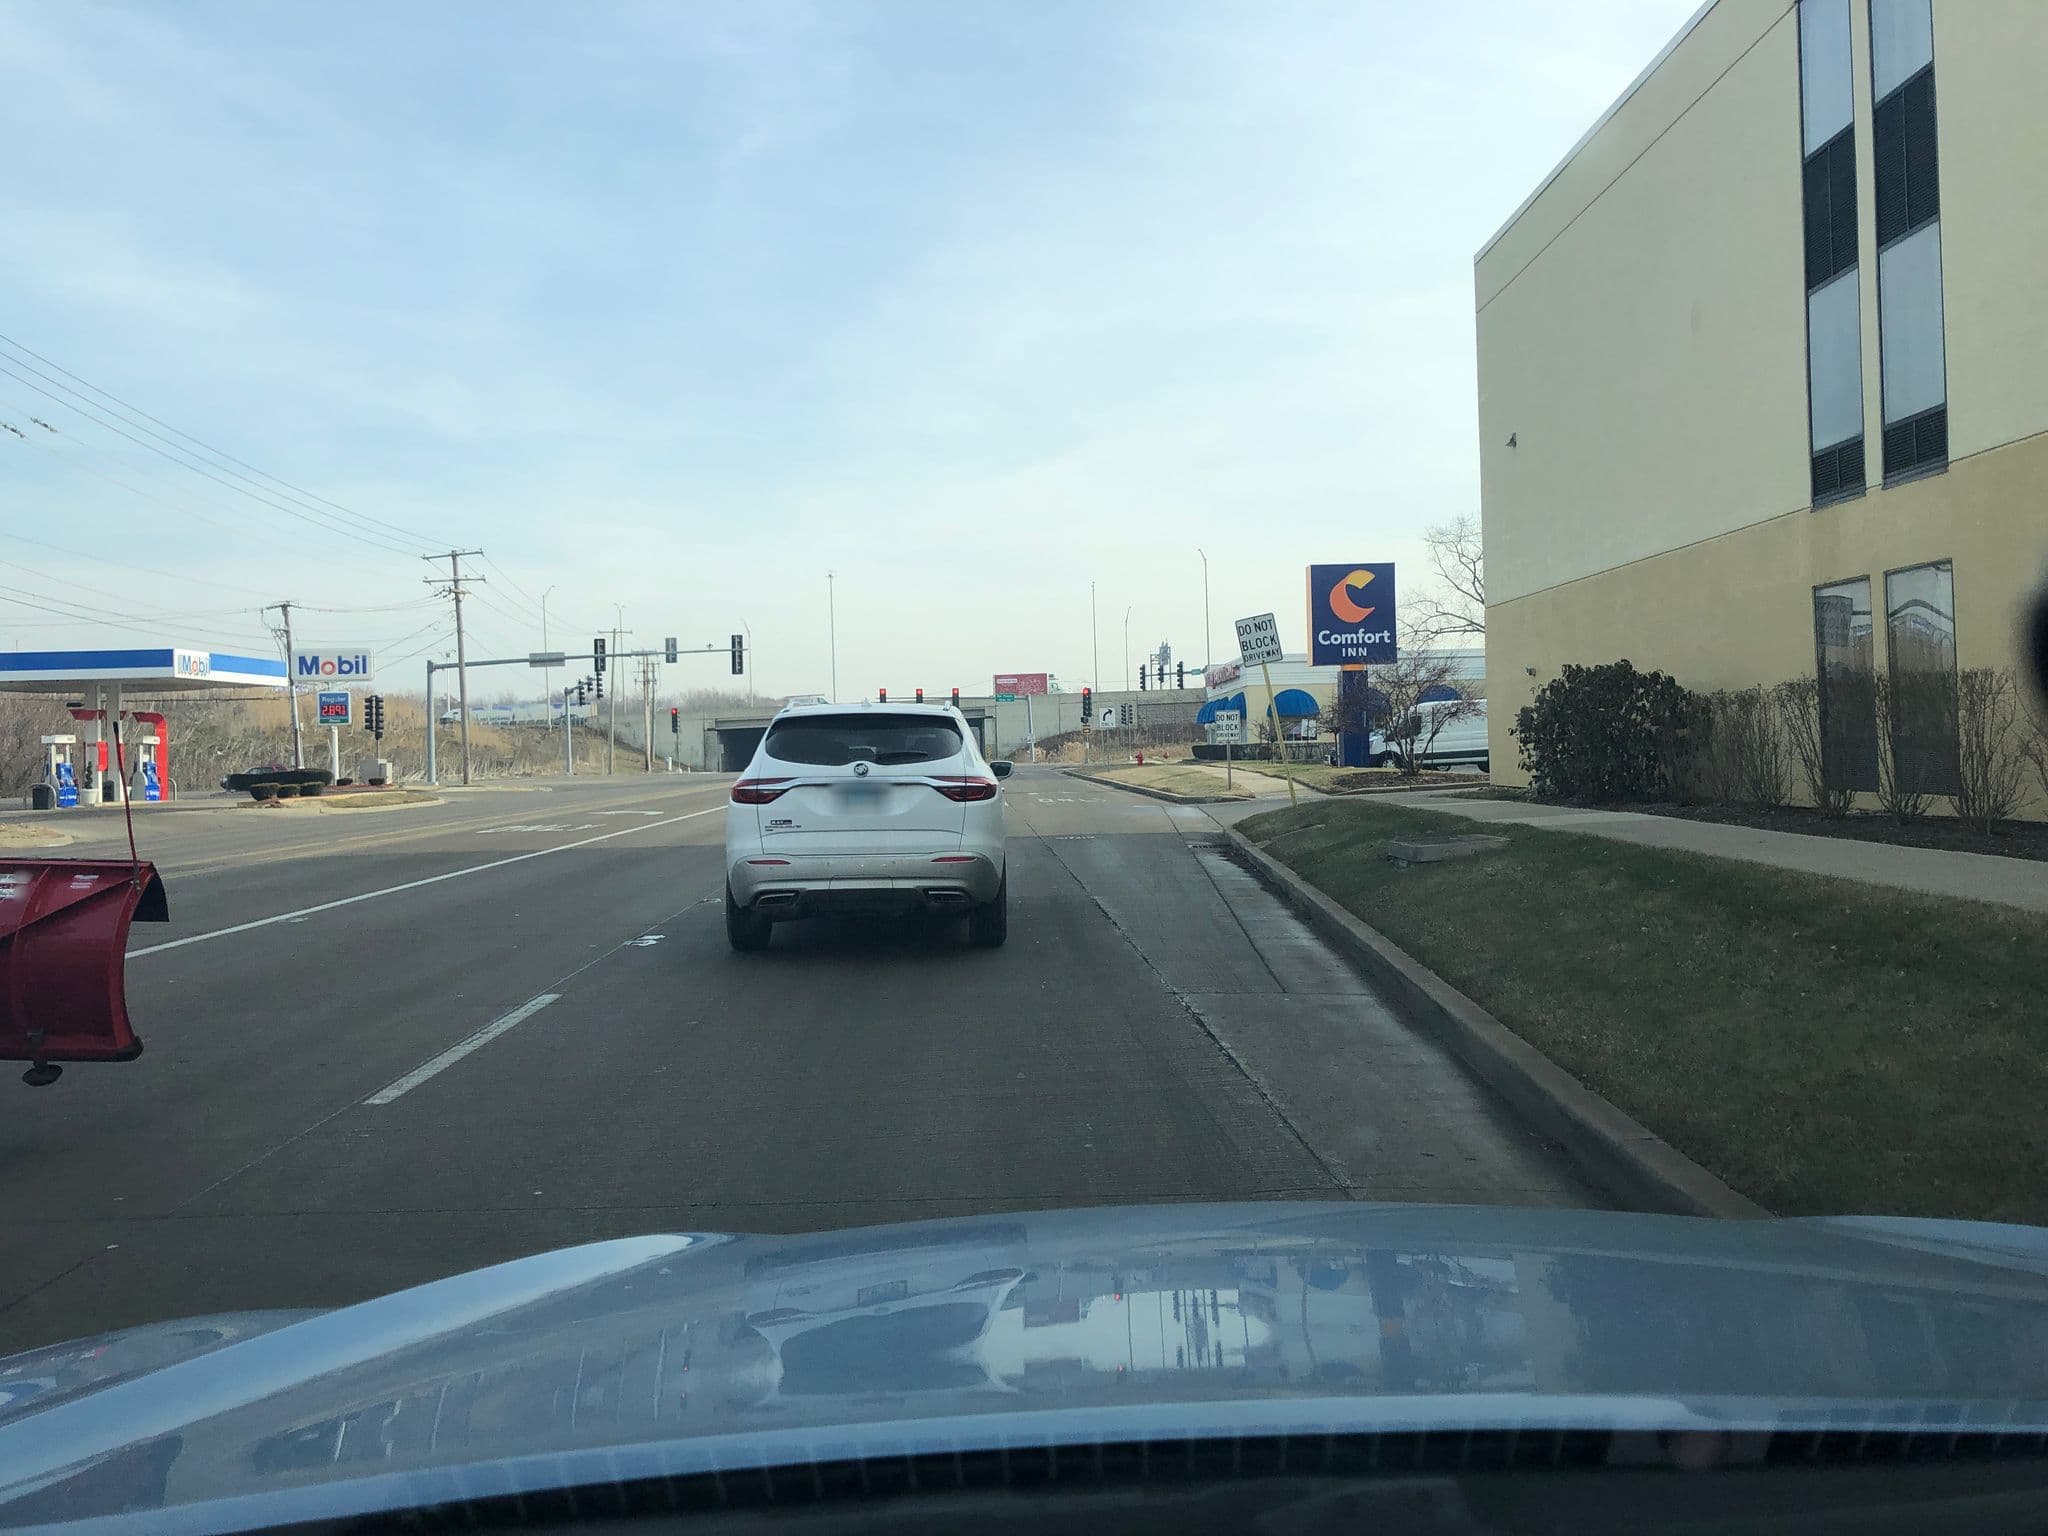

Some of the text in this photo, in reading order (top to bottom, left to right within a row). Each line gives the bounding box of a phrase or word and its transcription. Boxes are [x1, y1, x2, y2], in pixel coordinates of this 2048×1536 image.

[1238, 619, 1273, 637] DO NOT
[1241, 635, 1277, 652] BLOCK
[1318, 628, 1391, 645] Comfort
[1243, 647, 1280, 662] DRIVEWAY
[1342, 647, 1367, 657] INN
[298, 655, 367, 676] Mobil
[1216, 713, 1239, 722] DO NOT
[1216, 723, 1239, 732] BLOCK
